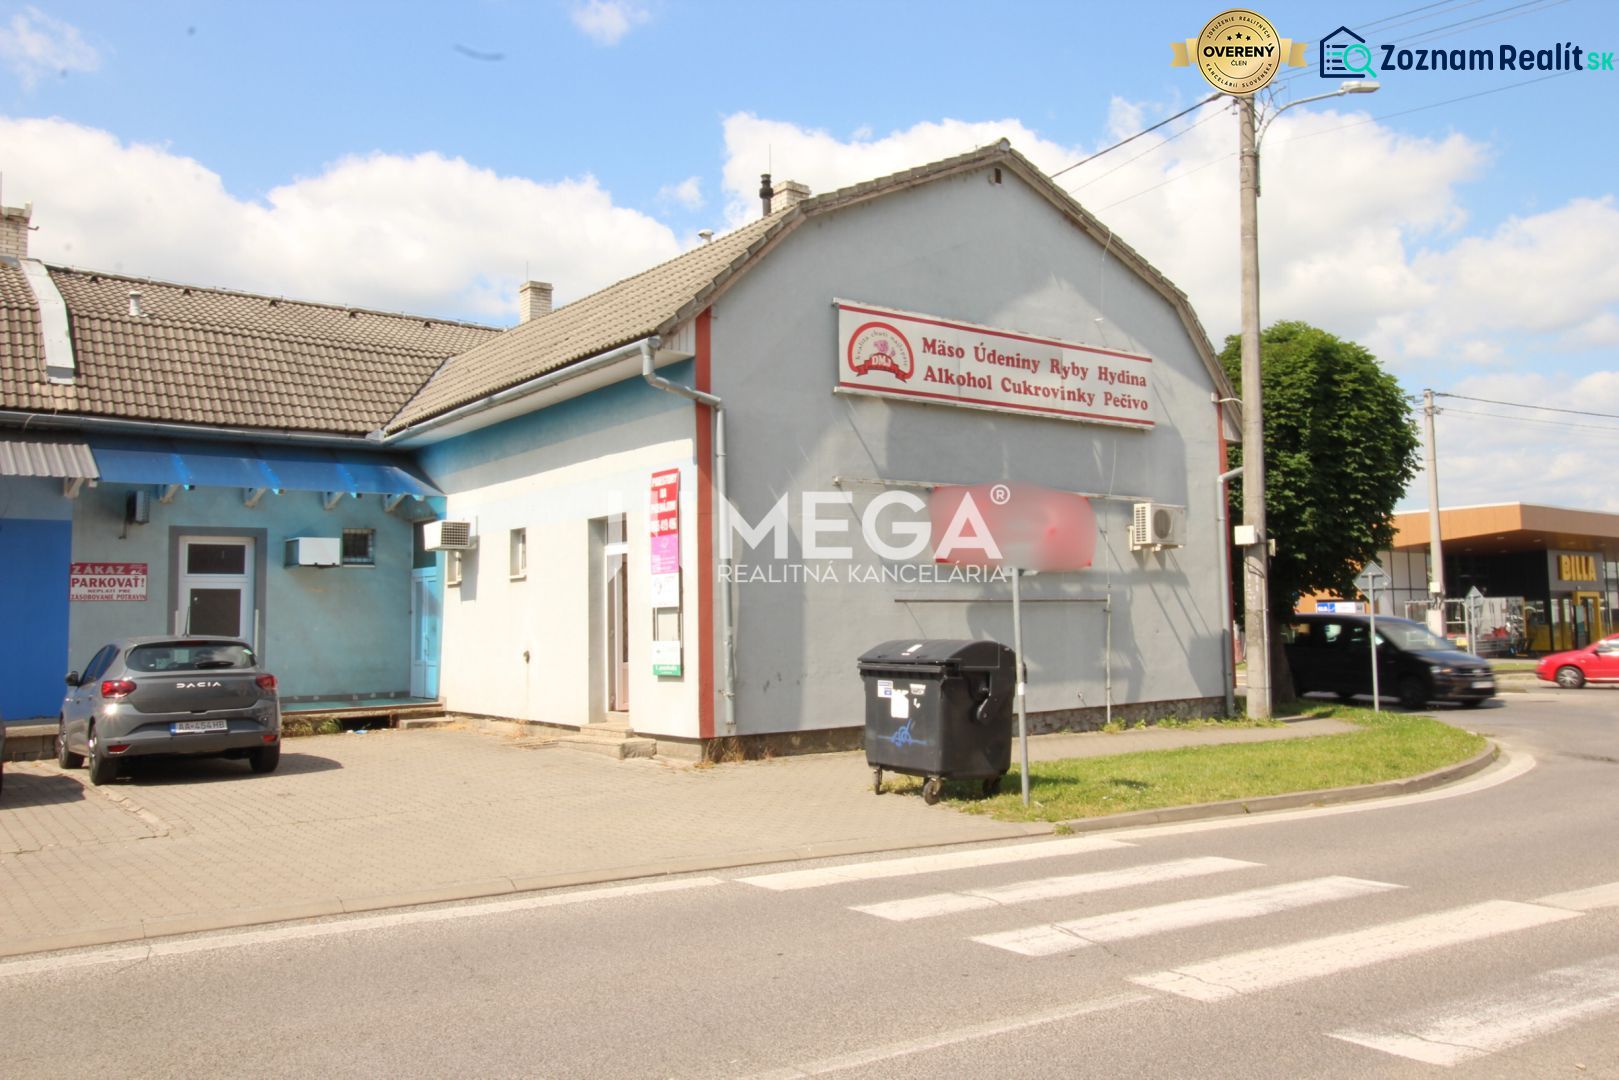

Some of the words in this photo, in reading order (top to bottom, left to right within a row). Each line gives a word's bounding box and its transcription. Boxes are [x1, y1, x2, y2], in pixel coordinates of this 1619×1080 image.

[922, 336, 966, 359] Mäso
[973, 342, 1040, 374] Údeniny
[1049, 358, 1089, 381] Ryby
[1097, 365, 1147, 387] Hydina
[923, 365, 993, 390] Alkohol
[1000, 376, 1096, 407] Cukrovinky
[1103, 391, 1149, 411] Pečivo
[71, 564, 126, 575] ZÁKAZ
[1557, 554, 1598, 582] BILLA
[71, 576, 145, 588] PARKOVAŤ!
[176, 681, 222, 689] DACIA
